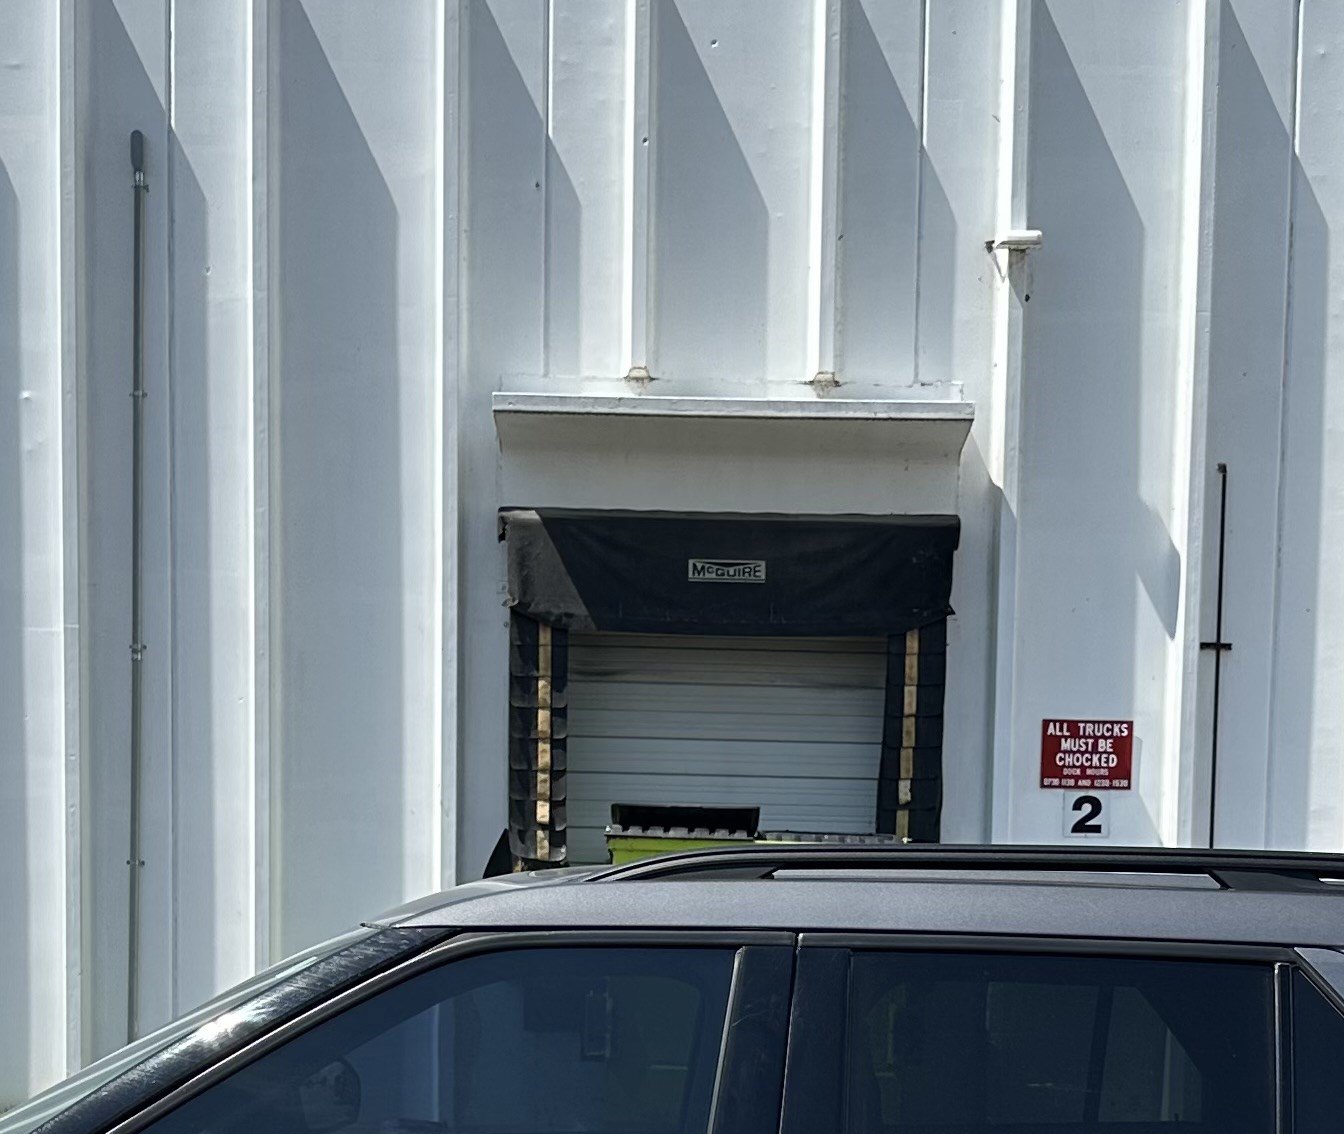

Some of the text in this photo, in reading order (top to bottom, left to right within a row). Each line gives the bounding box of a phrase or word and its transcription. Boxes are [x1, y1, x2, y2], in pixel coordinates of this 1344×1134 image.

[1047, 722, 1129, 737] ALL TRUCKS
[1060, 738, 1114, 752] MUST BE
[1055, 753, 1118, 768] CHOCKED
[1070, 794, 1103, 834] 2
